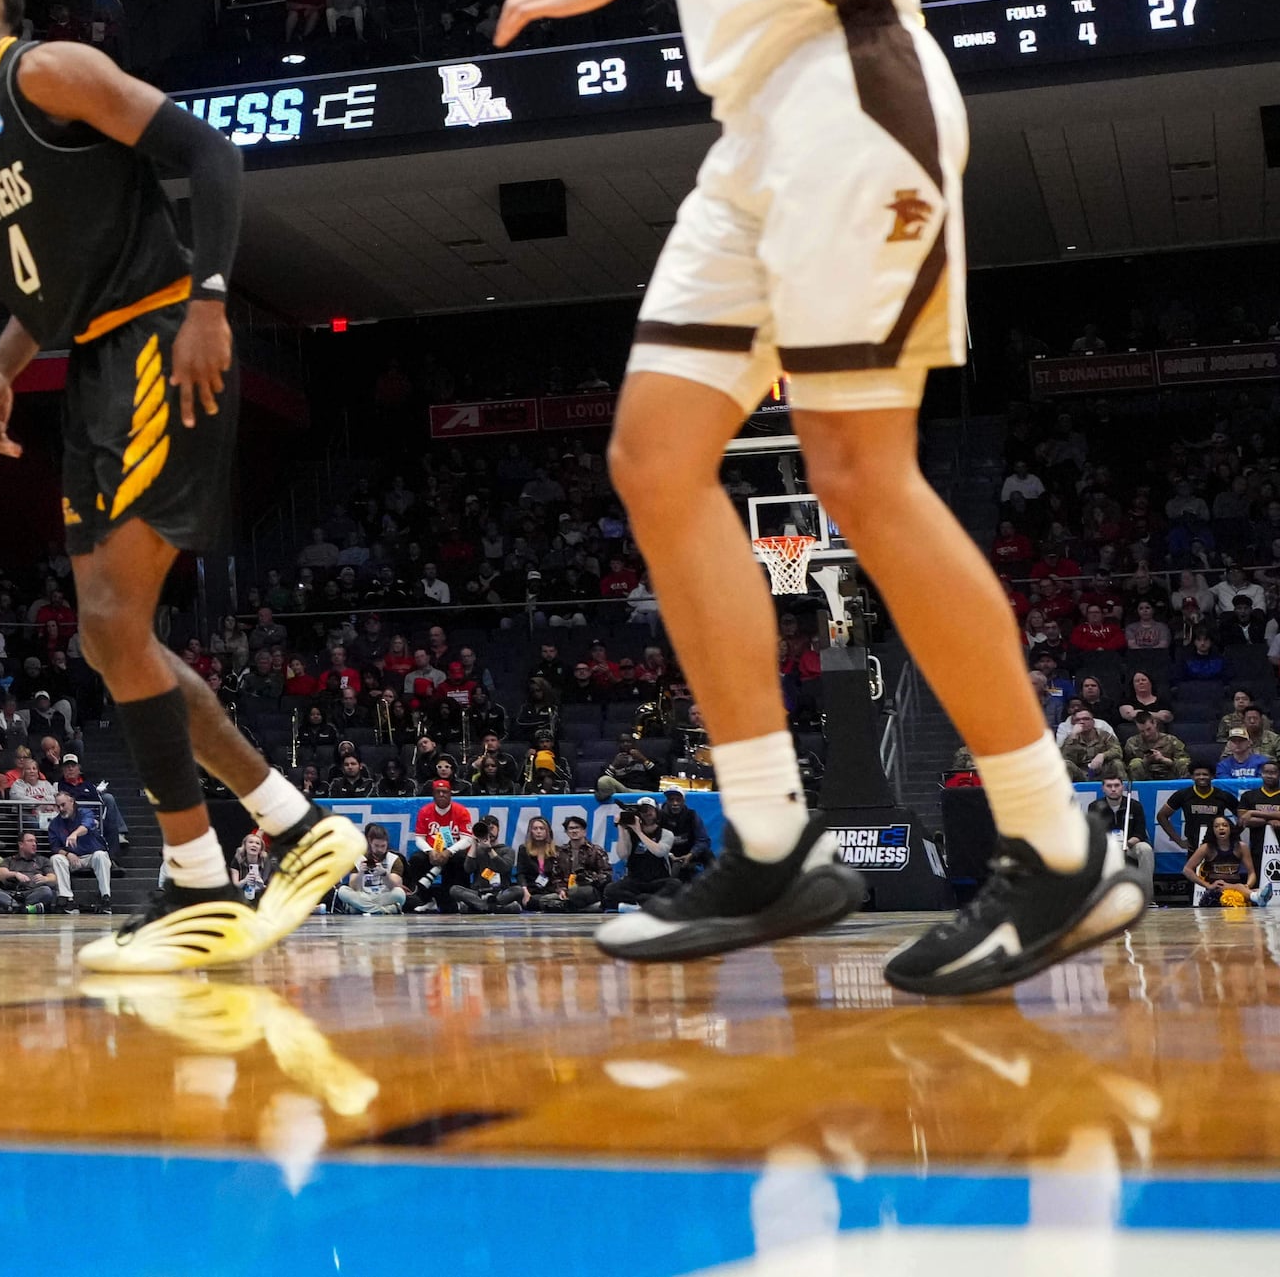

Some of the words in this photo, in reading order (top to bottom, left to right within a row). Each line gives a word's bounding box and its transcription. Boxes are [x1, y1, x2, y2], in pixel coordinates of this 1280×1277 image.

[1006, 5, 1047, 21] FOULS
[1071, 0, 1096, 13] TOL
[953, 31, 997, 48] BONUS
[1018, 30, 1037, 53] 2
[1078, 22, 1097, 45] 4
[660, 47, 683, 61] TOL
[576, 57, 628, 96] 23
[665, 69, 684, 92] 4
[8, 224, 41, 295] 0
[566, 402, 615, 419] LOYOL
